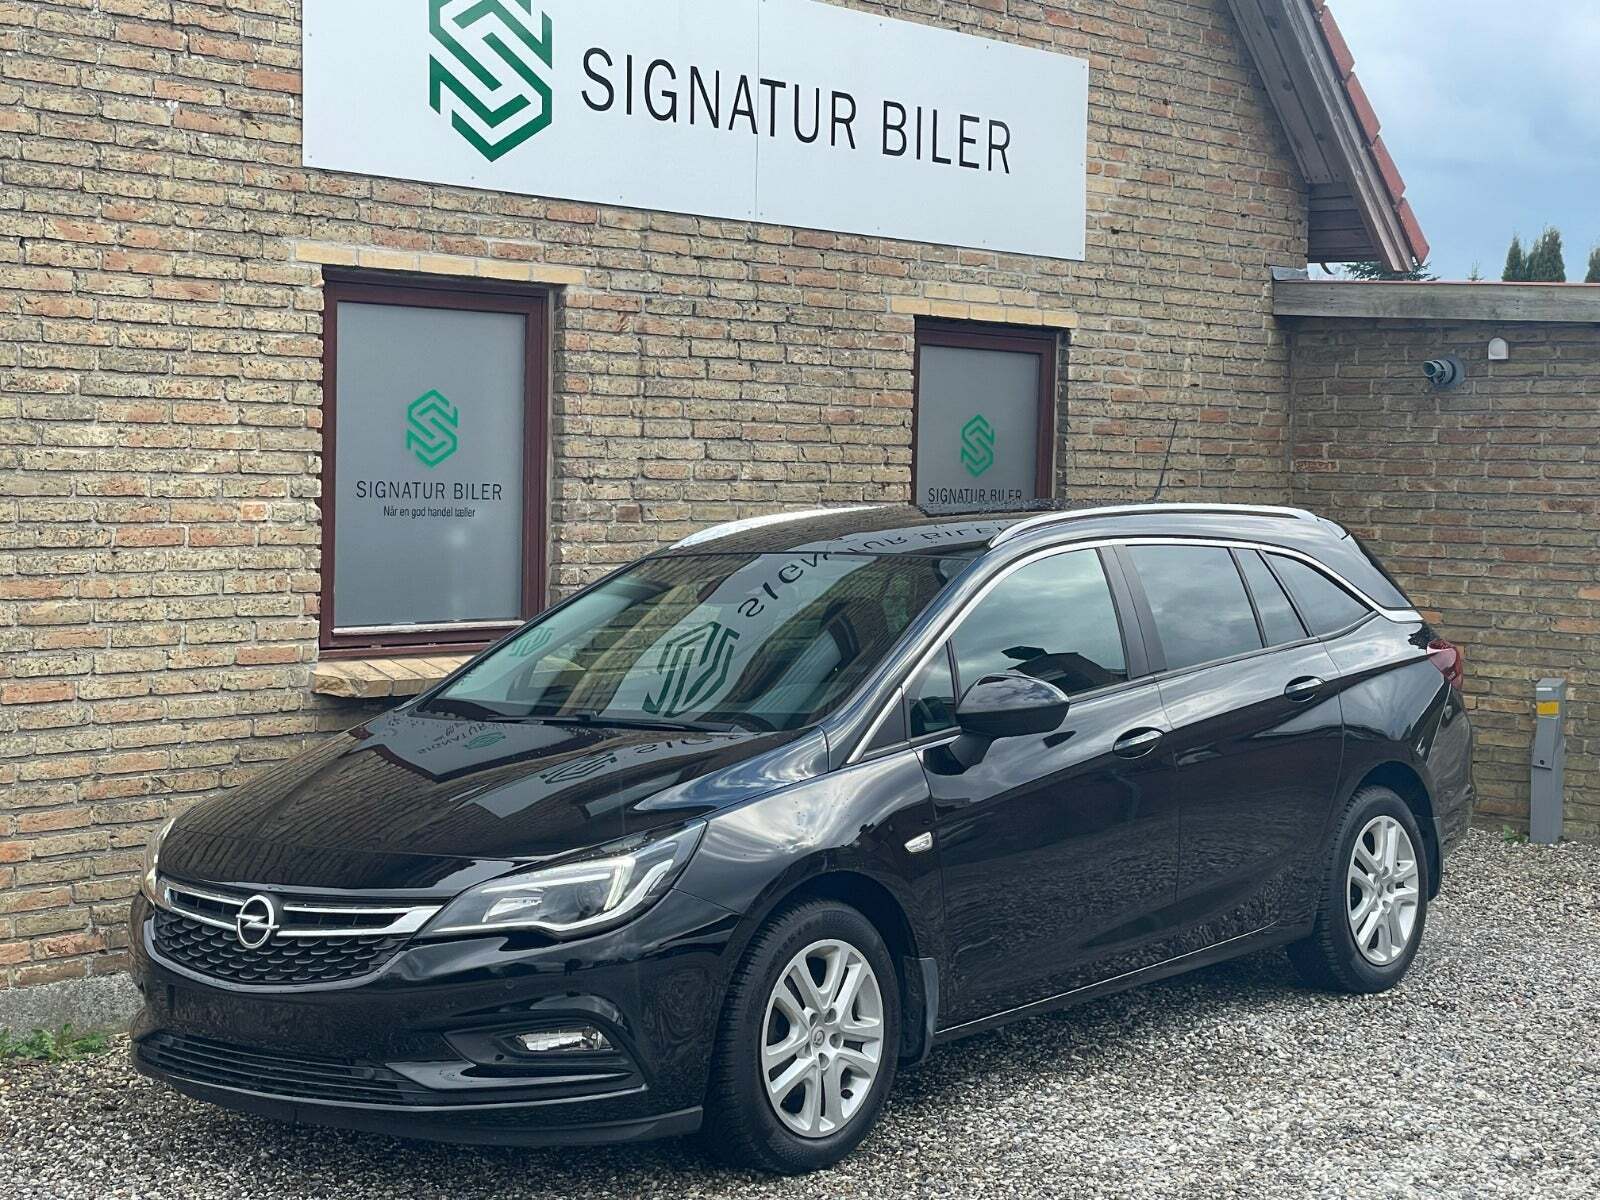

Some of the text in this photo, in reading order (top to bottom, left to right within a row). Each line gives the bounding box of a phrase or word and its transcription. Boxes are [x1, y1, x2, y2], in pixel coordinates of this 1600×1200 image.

[581, 47, 1012, 174] SIGNATUR BILER
[356, 480, 503, 501] SIGNATUR BILER
[928, 487, 986, 504] SIGNATUR
[384, 506, 399, 517] Når
[400, 509, 410, 517] en
[411, 507, 426, 519] god
[427, 506, 454, 517] handel
